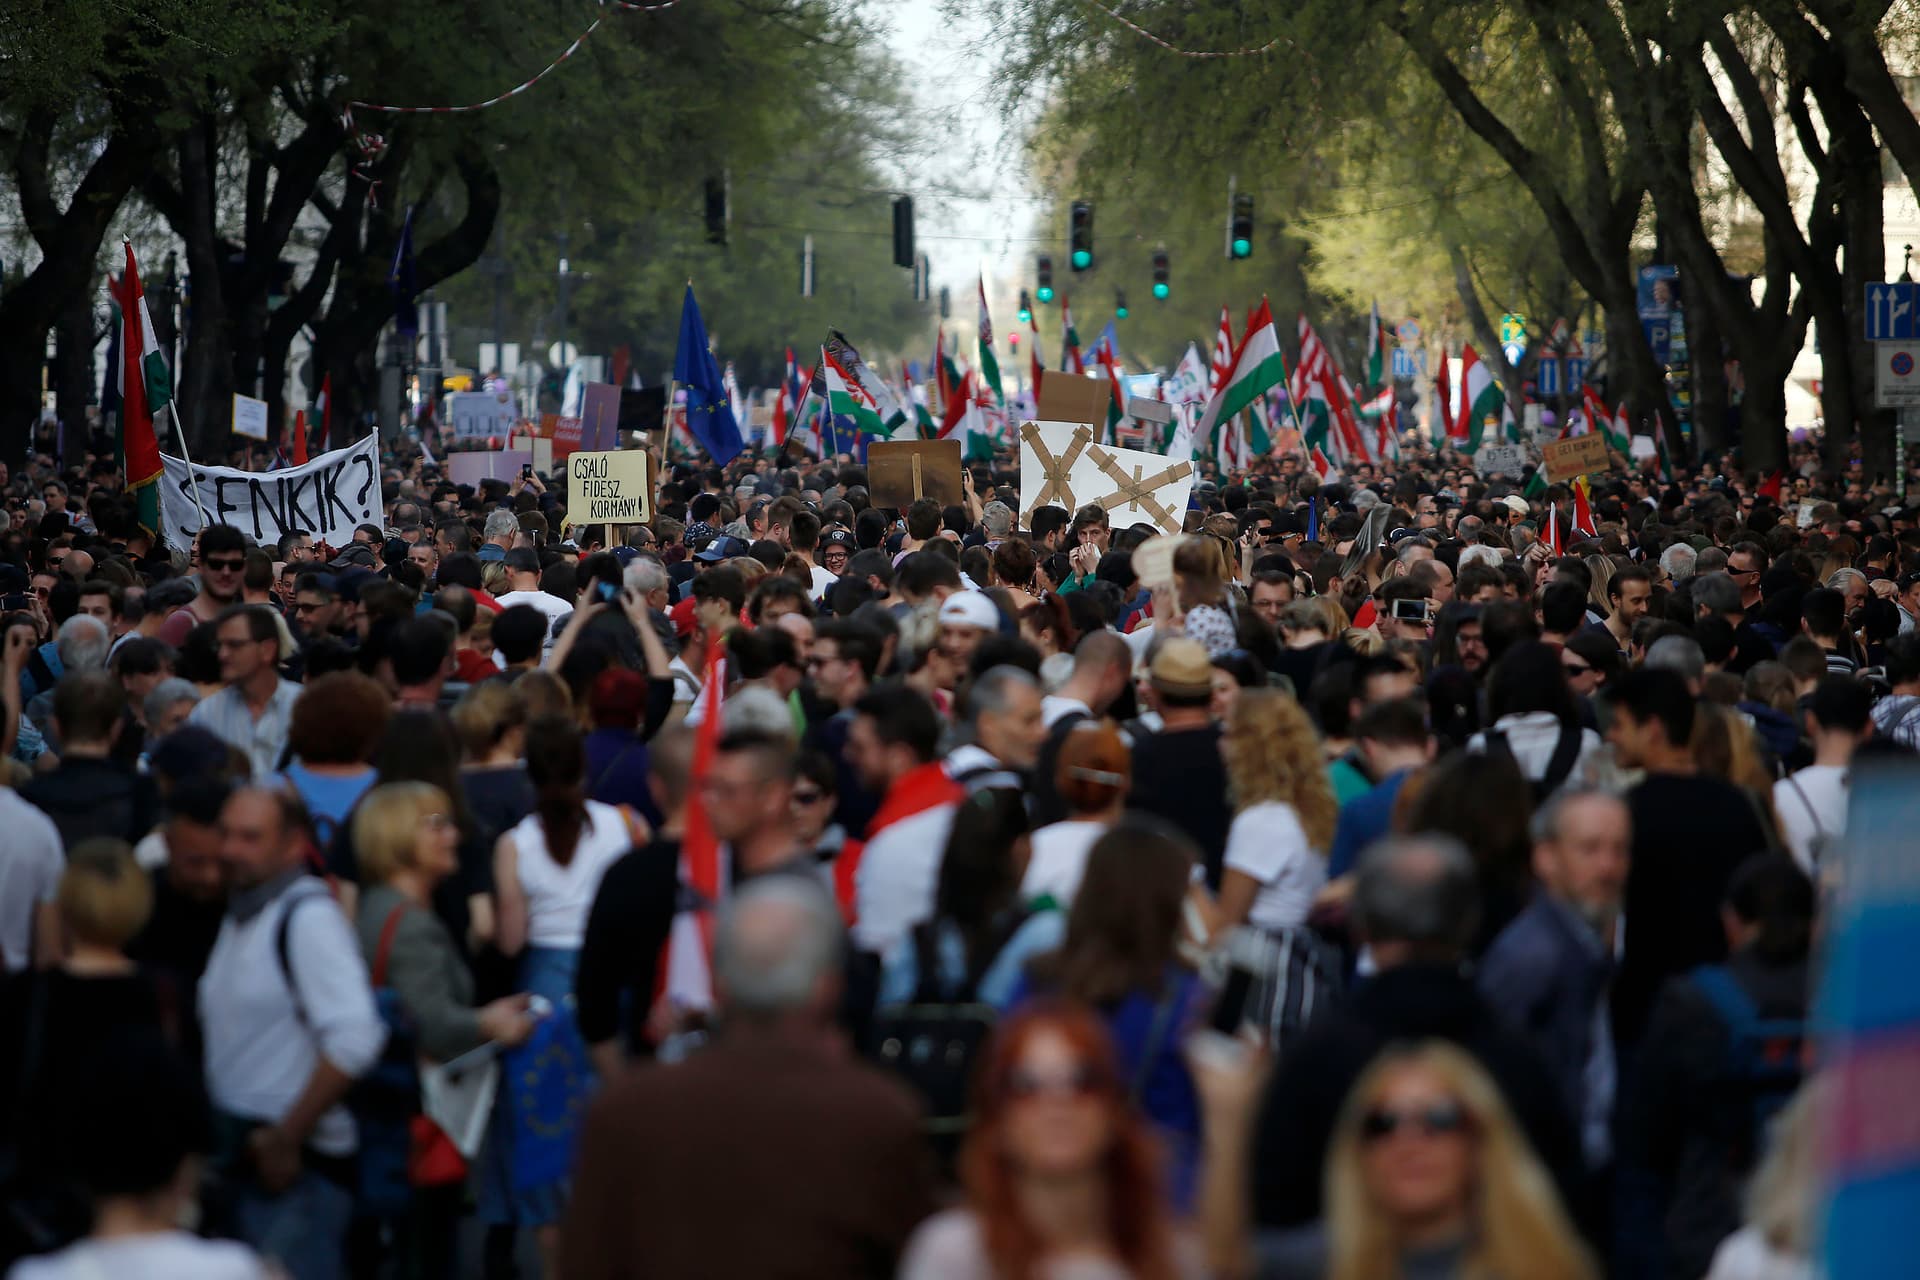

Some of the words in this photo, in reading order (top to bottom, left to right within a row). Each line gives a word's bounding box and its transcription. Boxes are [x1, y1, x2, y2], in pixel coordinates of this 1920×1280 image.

[1651, 327, 1668, 348] P
[574, 454, 608, 479] CSALÓ
[583, 480, 620, 498] FIDESZ
